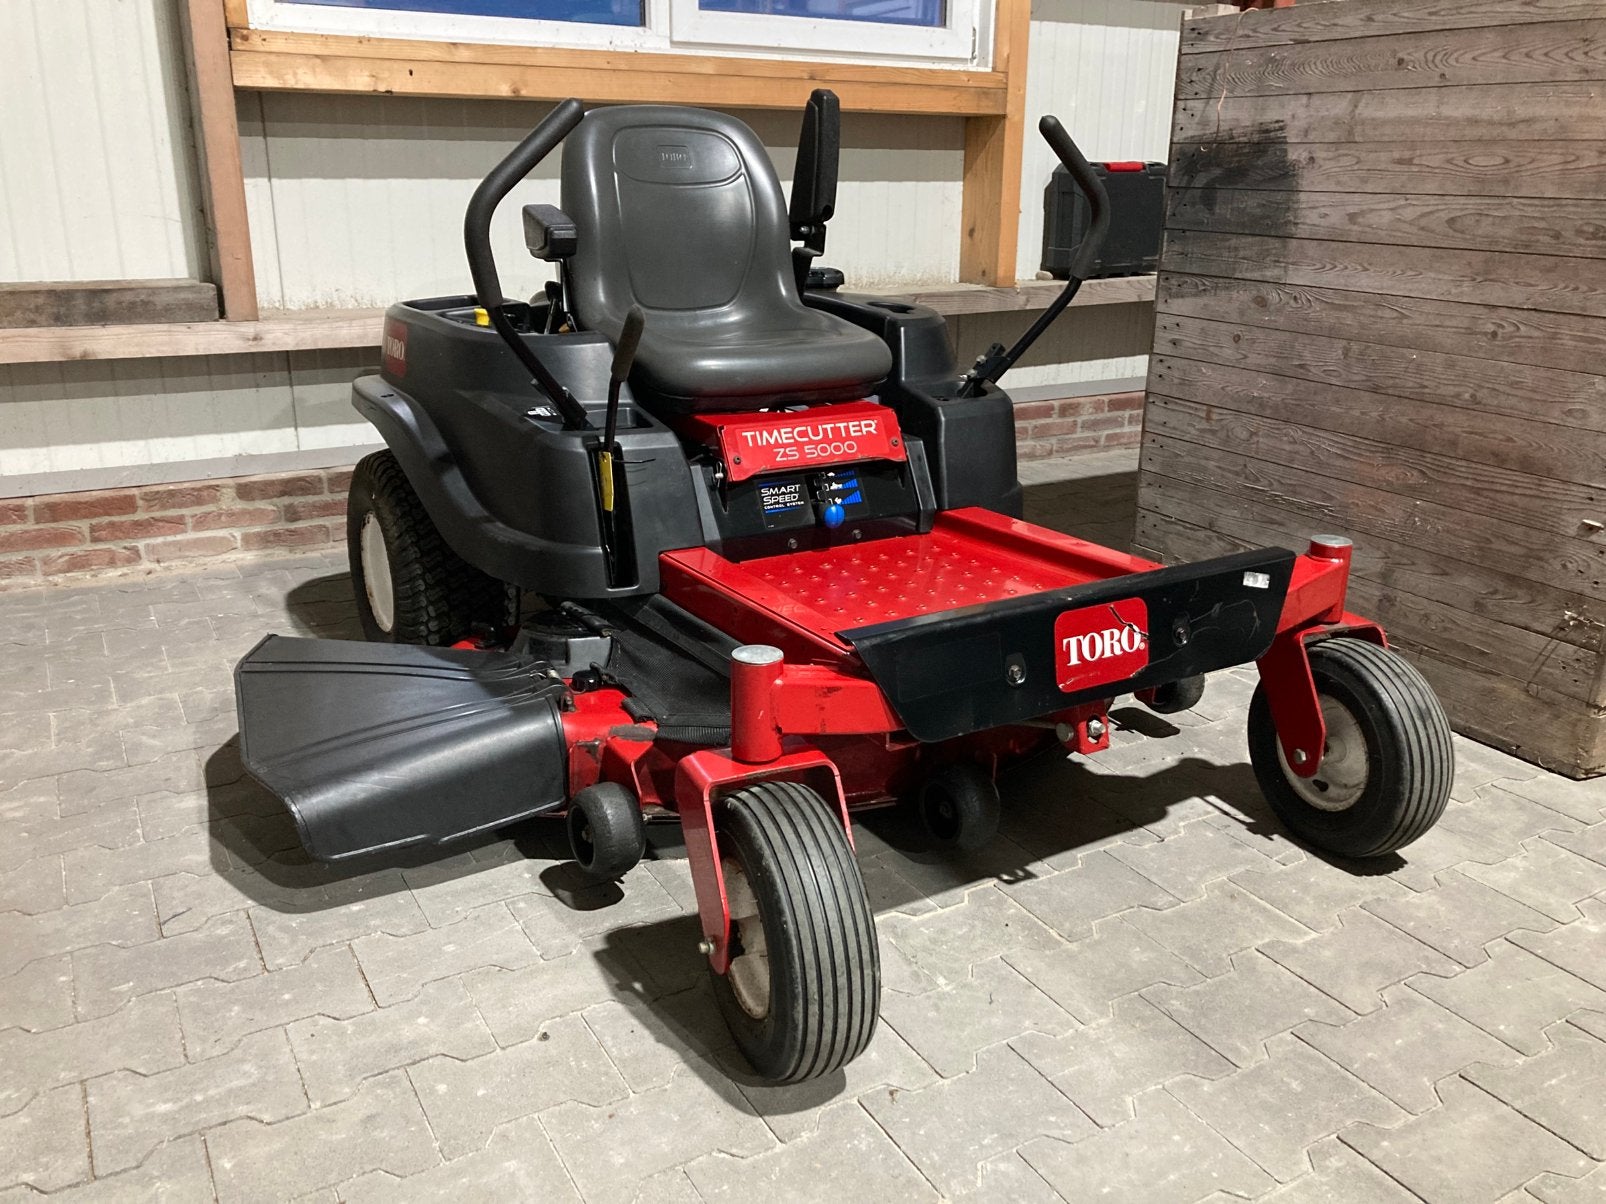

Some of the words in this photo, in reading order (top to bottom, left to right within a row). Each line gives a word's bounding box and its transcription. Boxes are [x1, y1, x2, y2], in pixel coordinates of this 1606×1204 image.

[741, 419, 877, 447] TIMECUTTER
[773, 447, 800, 462] ZS
[804, 440, 858, 459] 5000
[760, 484, 801, 497] SMART
[763, 493, 800, 505] SPEED
[786, 500, 805, 508] SYSTEM
[1062, 622, 1142, 667] TORO
